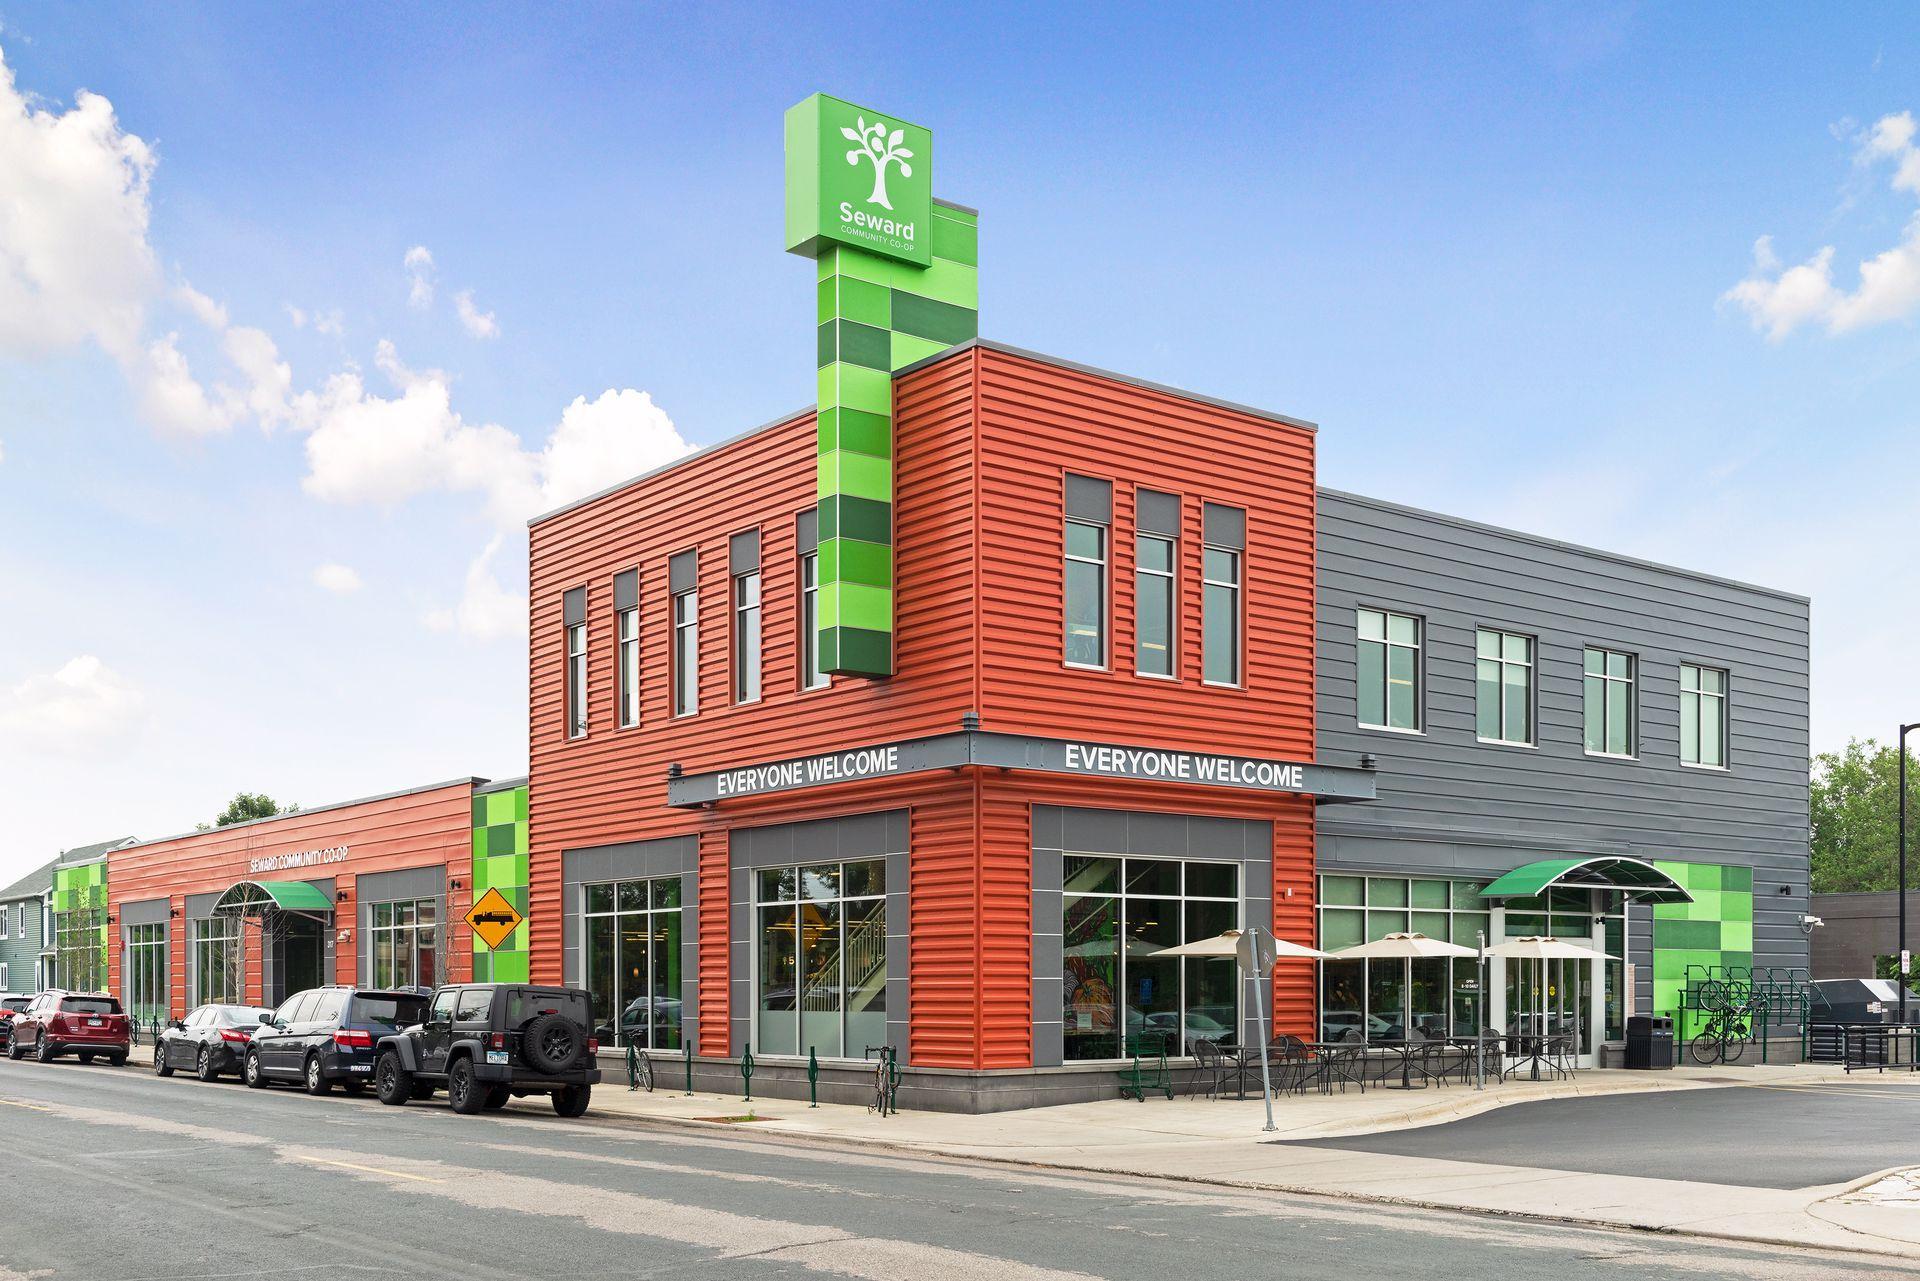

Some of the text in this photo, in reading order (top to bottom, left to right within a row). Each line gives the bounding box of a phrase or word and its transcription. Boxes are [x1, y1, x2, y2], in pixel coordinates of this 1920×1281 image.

[840, 202, 914, 241] Seward
[841, 225, 914, 252] COMMUNITY CO-OP
[717, 746, 898, 795] EVERYONE WELCOME
[1065, 744, 1303, 788] EVERYONE WELCOME
[250, 845, 348, 873] SEWARD COMMUNITY CO-OP
